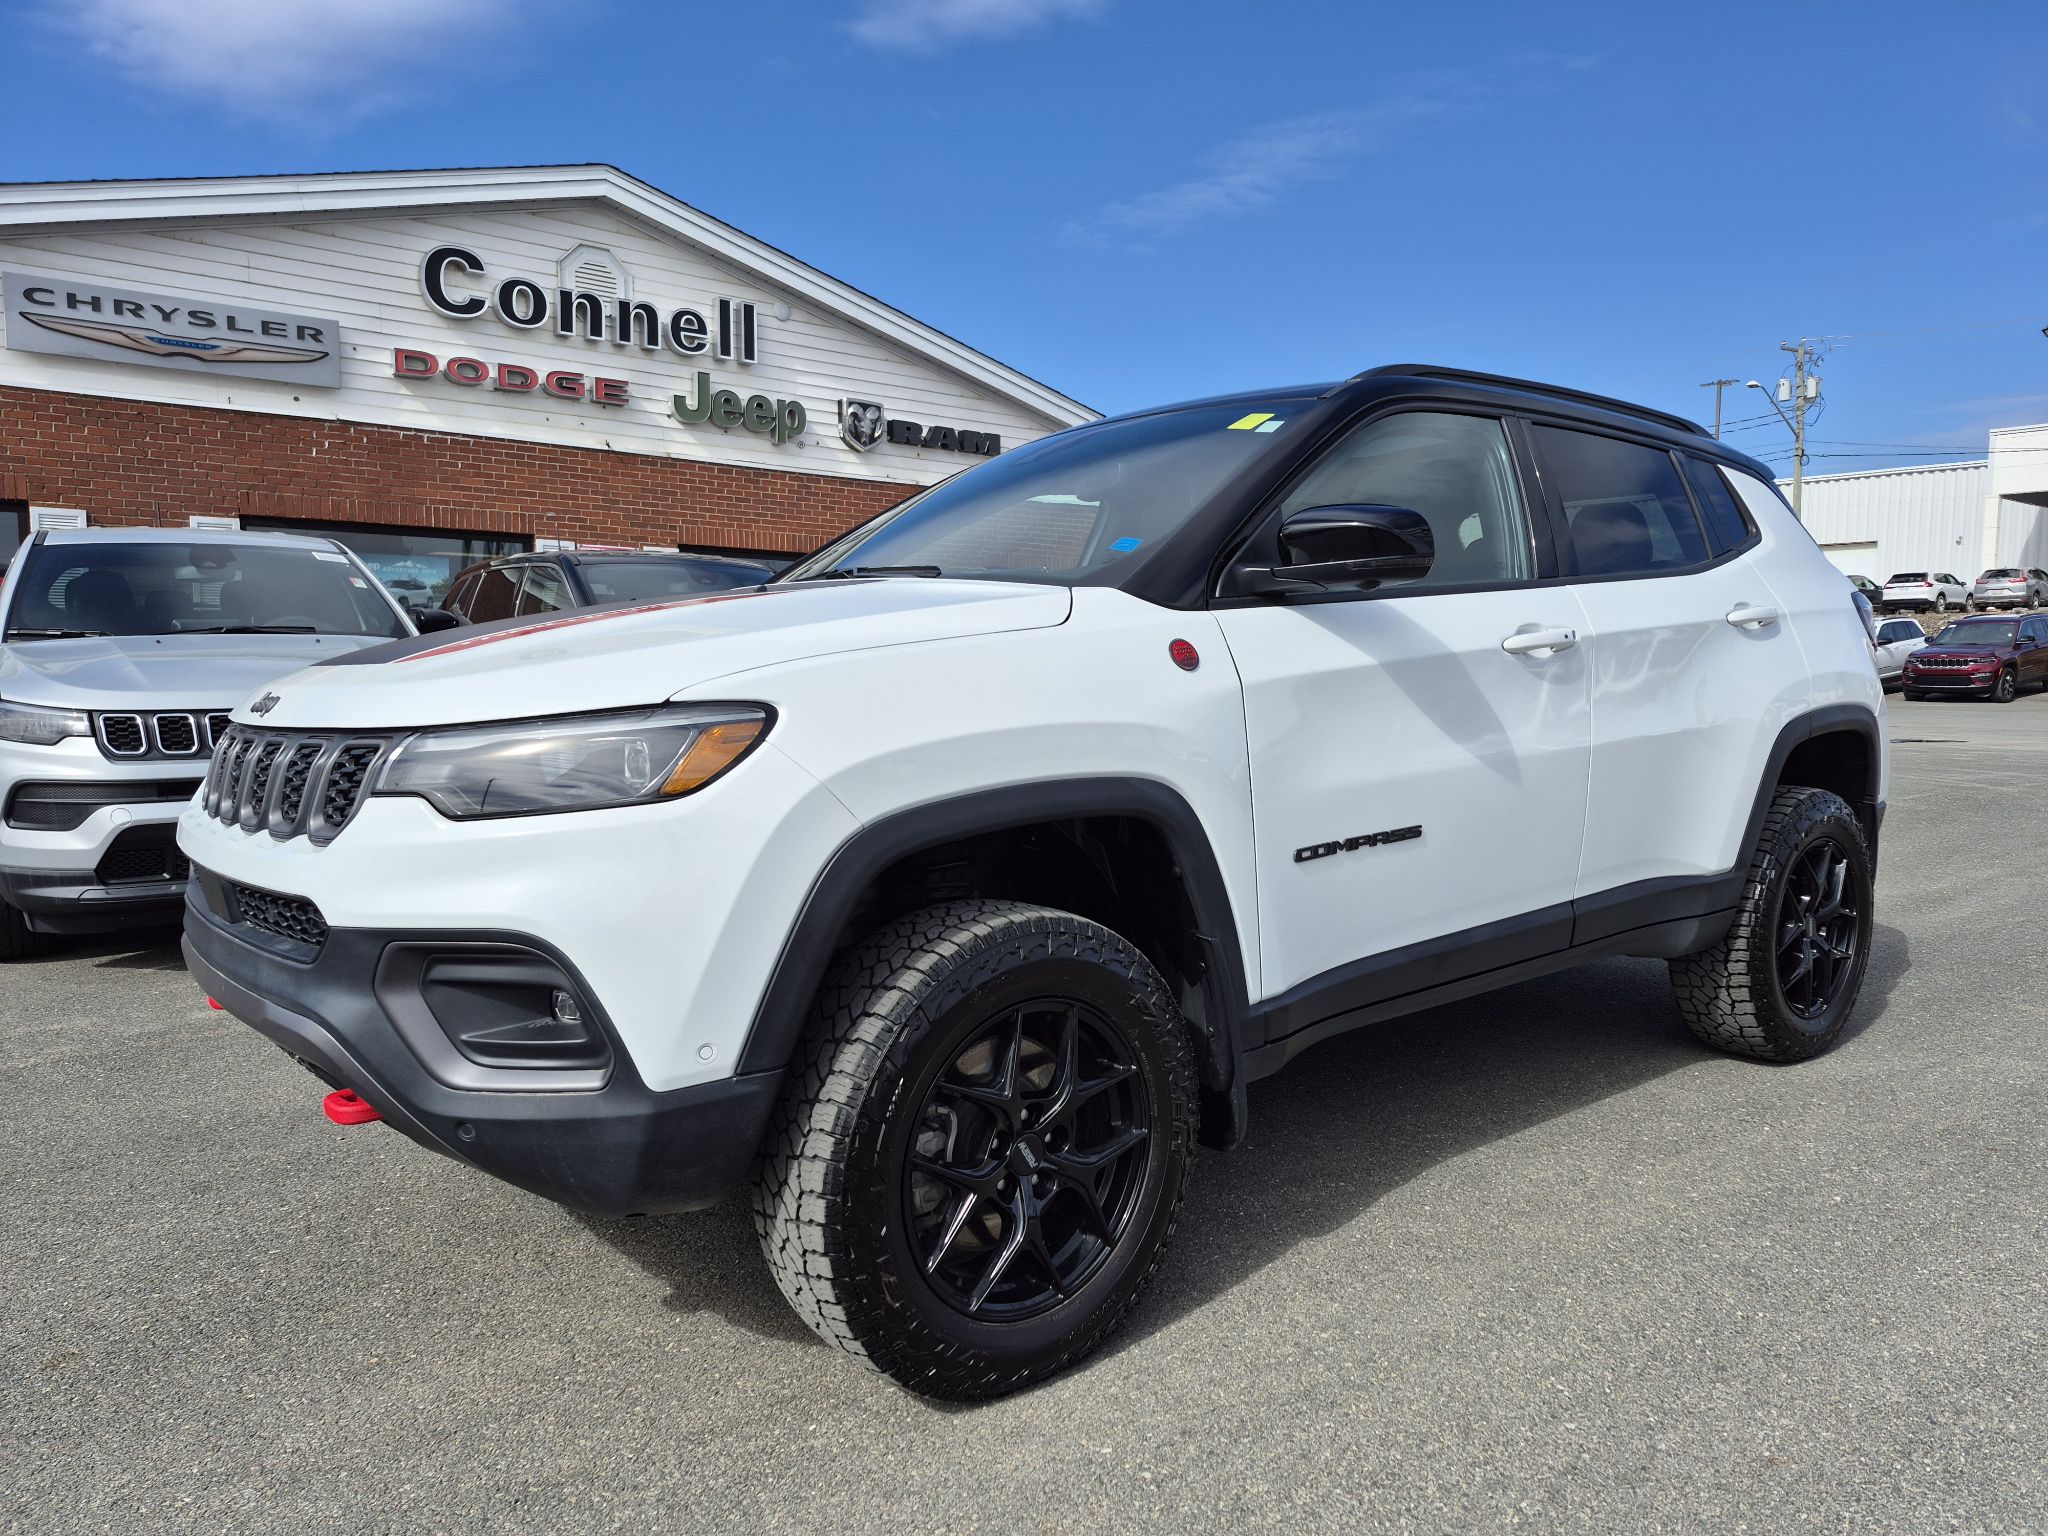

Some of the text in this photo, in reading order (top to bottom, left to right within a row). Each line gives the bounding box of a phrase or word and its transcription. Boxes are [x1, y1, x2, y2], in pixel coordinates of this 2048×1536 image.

[22, 286, 325, 344] CHRYSLER
[420, 244, 758, 364] Connell
[393, 347, 630, 406] DODGE
[672, 371, 807, 446] Jeep
[887, 419, 1001, 455] RAM
[1293, 824, 1423, 863] COMPASS
